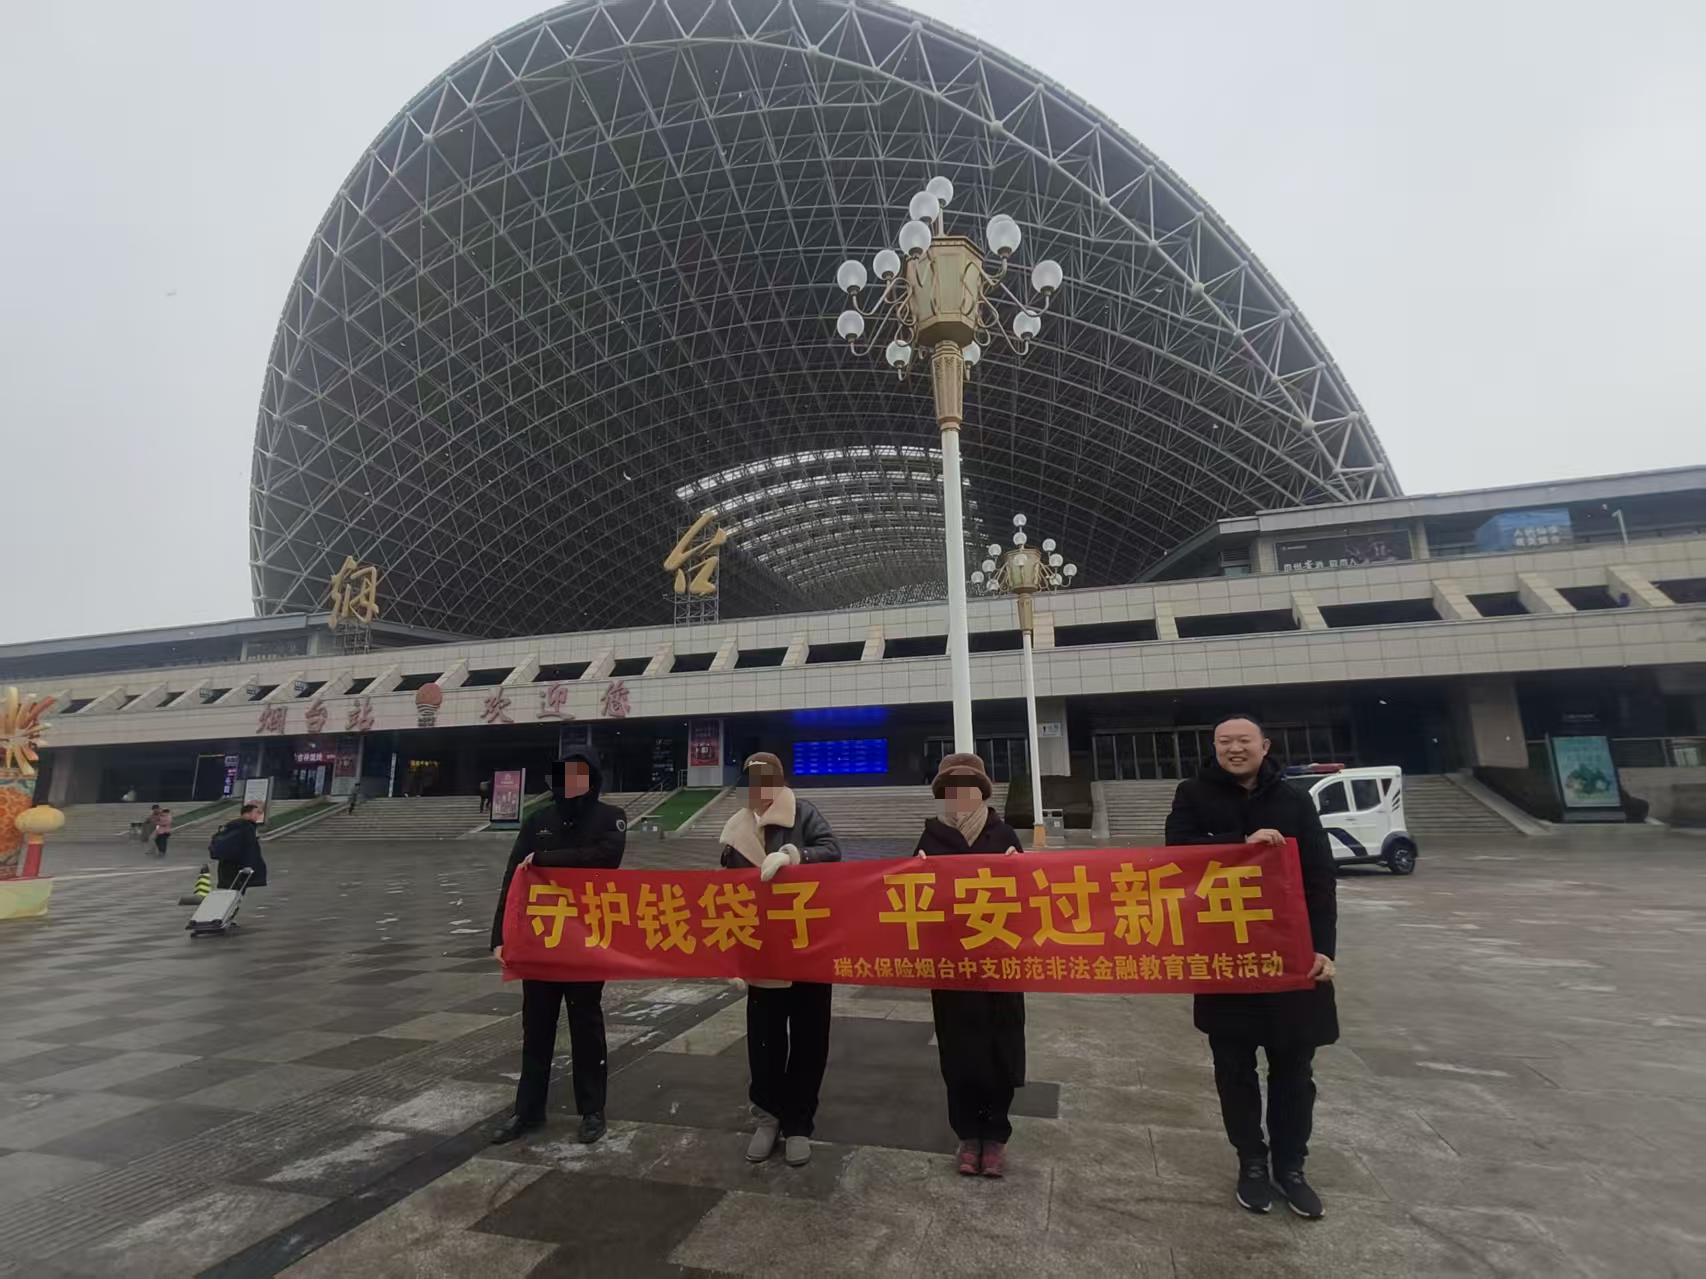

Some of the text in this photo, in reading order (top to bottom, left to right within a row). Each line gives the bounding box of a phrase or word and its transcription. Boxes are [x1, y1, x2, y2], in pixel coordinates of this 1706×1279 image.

[256, 680, 631, 736] 烟台站 欢迎您
[526, 860, 1274, 954] 守护钱袋子 平安过新年
[833, 950, 1285, 981] 瑞众保险烟台中支防范非法金融教育宣传活动
